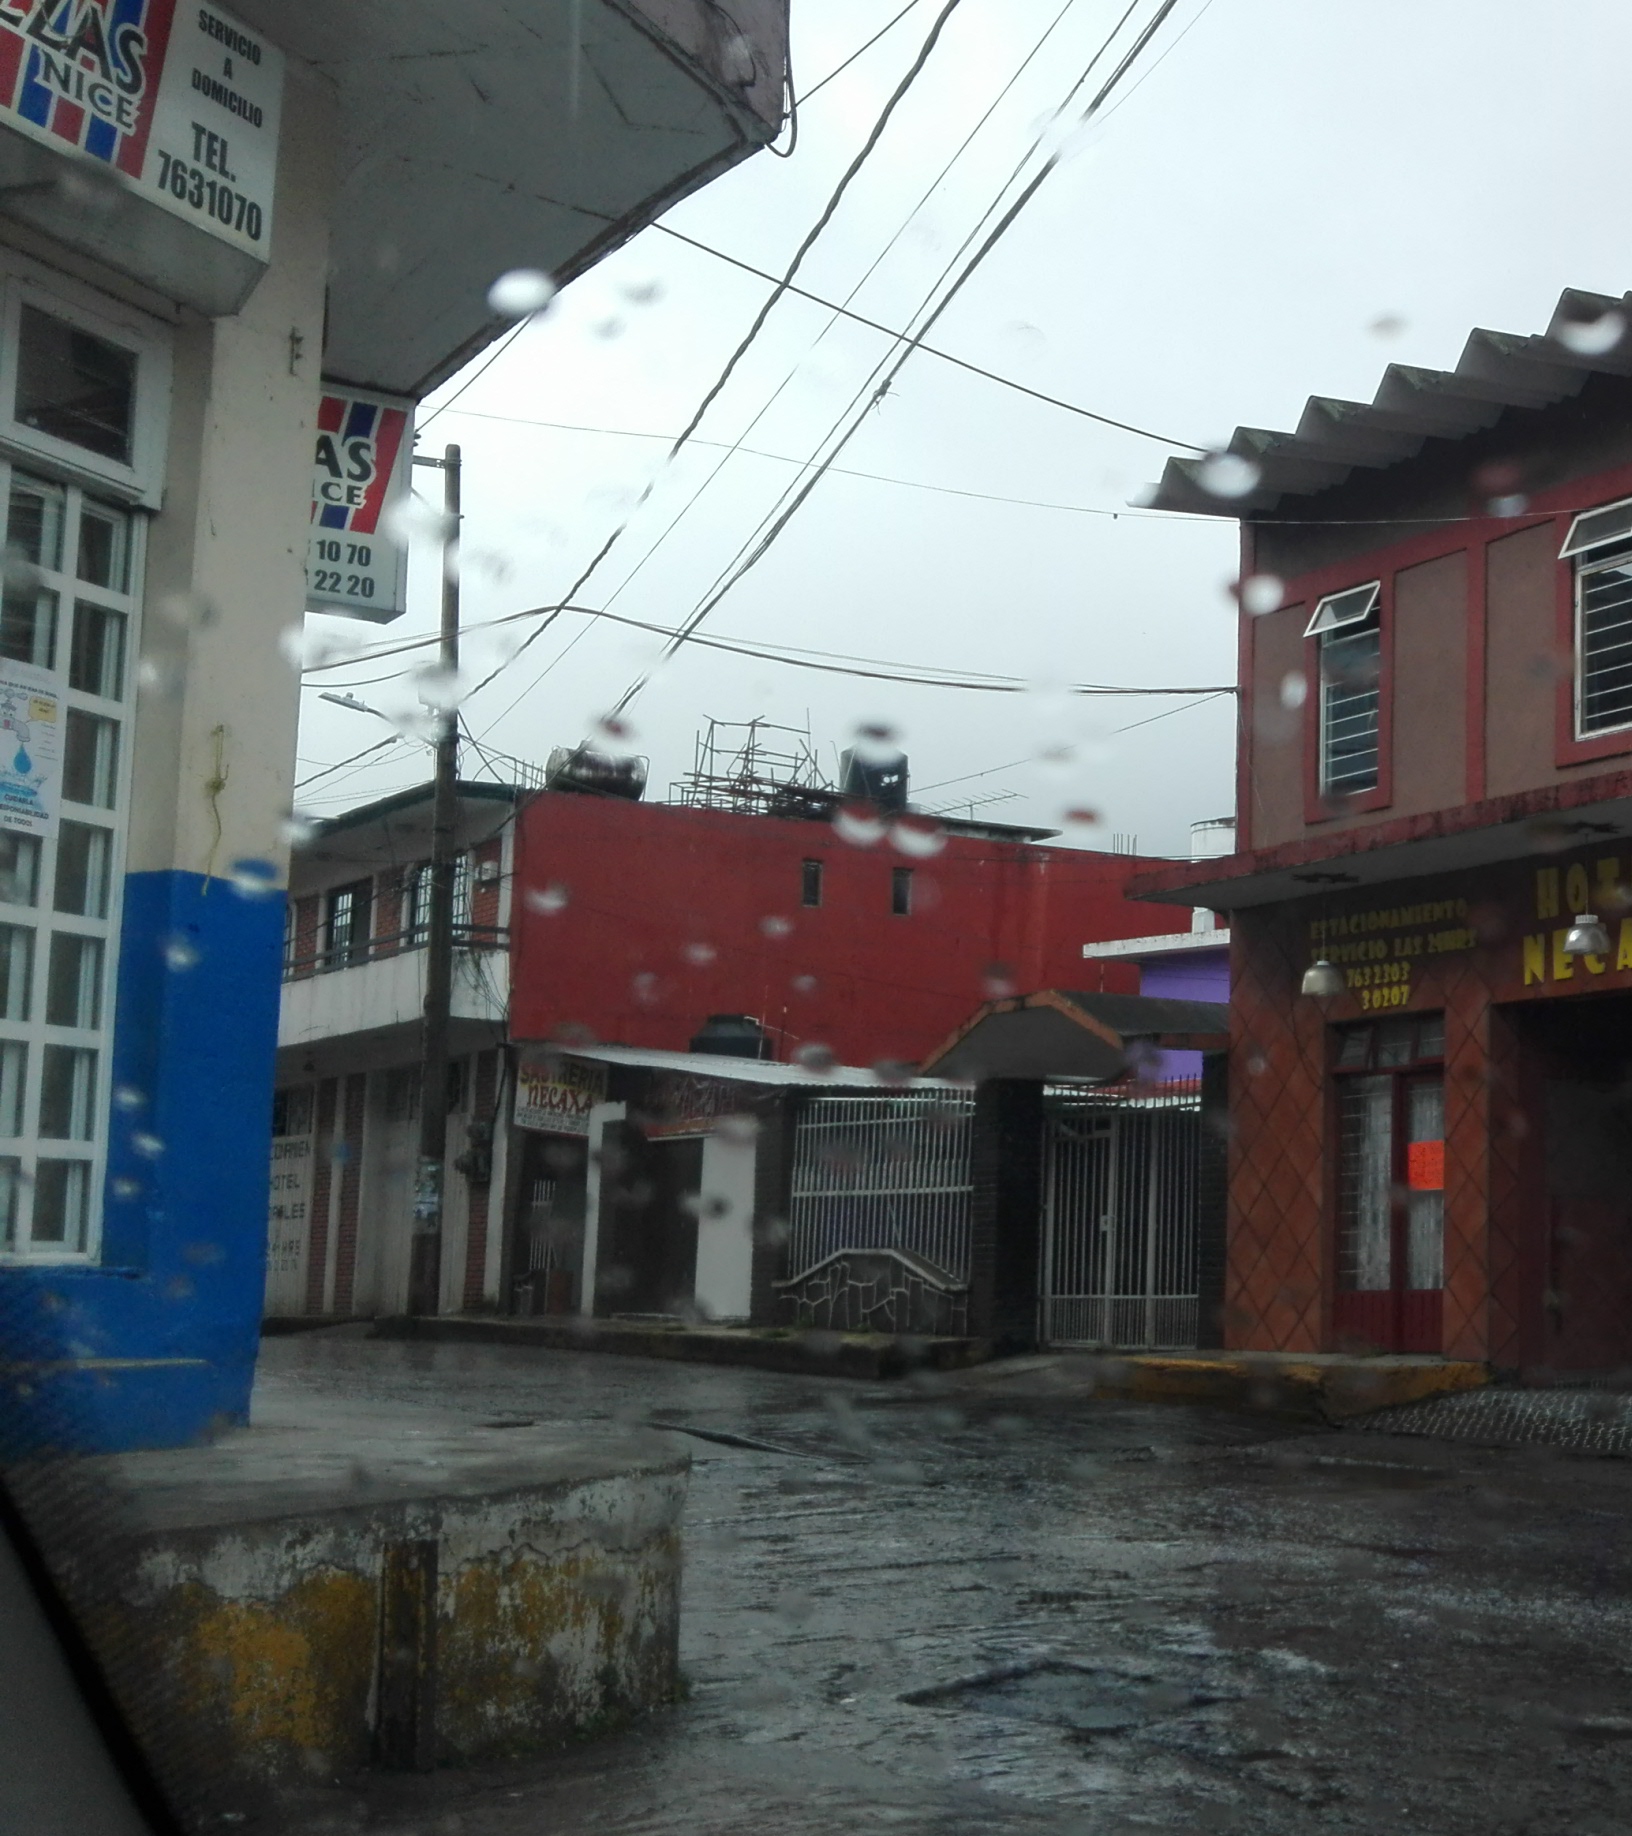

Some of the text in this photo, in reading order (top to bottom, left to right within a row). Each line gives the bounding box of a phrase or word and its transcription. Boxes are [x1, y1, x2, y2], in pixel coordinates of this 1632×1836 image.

[199, 9, 262, 66] SERVICIO
[41, 50, 133, 129] NICE
[223, 57, 233, 80] A
[191, 67, 263, 128] DOMICILIO
[191, 121, 237, 183] TEL.
[157, 149, 262, 241] 7631070
[316, 540, 372, 567] 10 70
[314, 569, 375, 598] 22 20
[1310, 938, 1389, 964] SERVICIO
[526, 1084, 593, 1115] NECAXA
